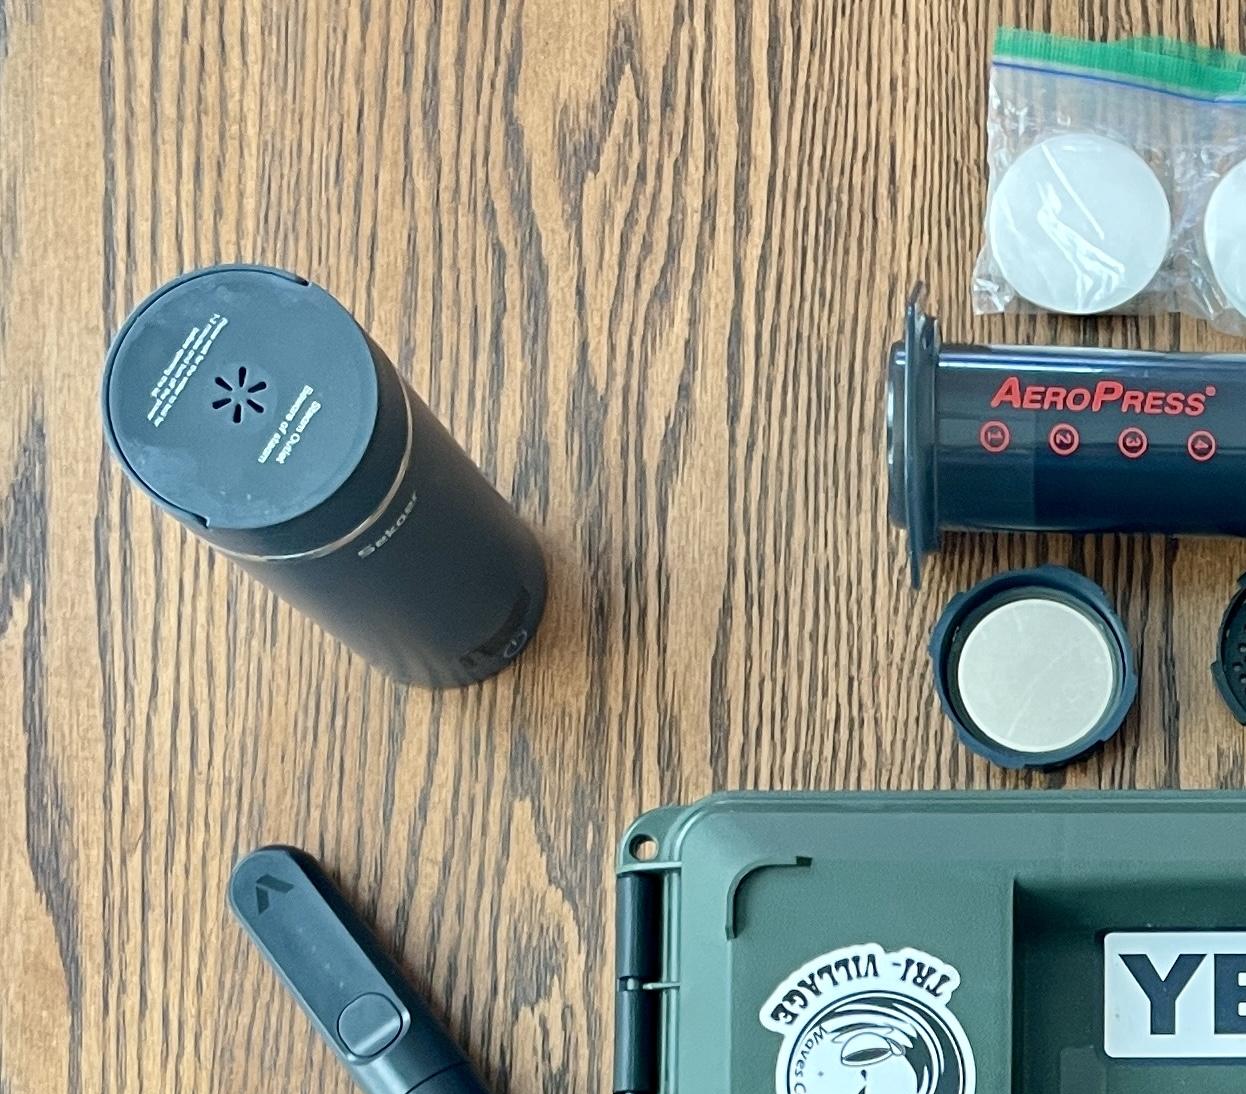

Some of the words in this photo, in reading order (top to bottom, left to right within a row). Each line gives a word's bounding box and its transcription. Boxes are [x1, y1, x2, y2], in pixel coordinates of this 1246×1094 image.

[286, 385, 314, 421] Beware
[279, 421, 288, 435] of
[276, 433, 300, 464] Outlet
[770, 953, 880, 1025] VILLAGE
[794, 1024, 827, 1078] Waves
